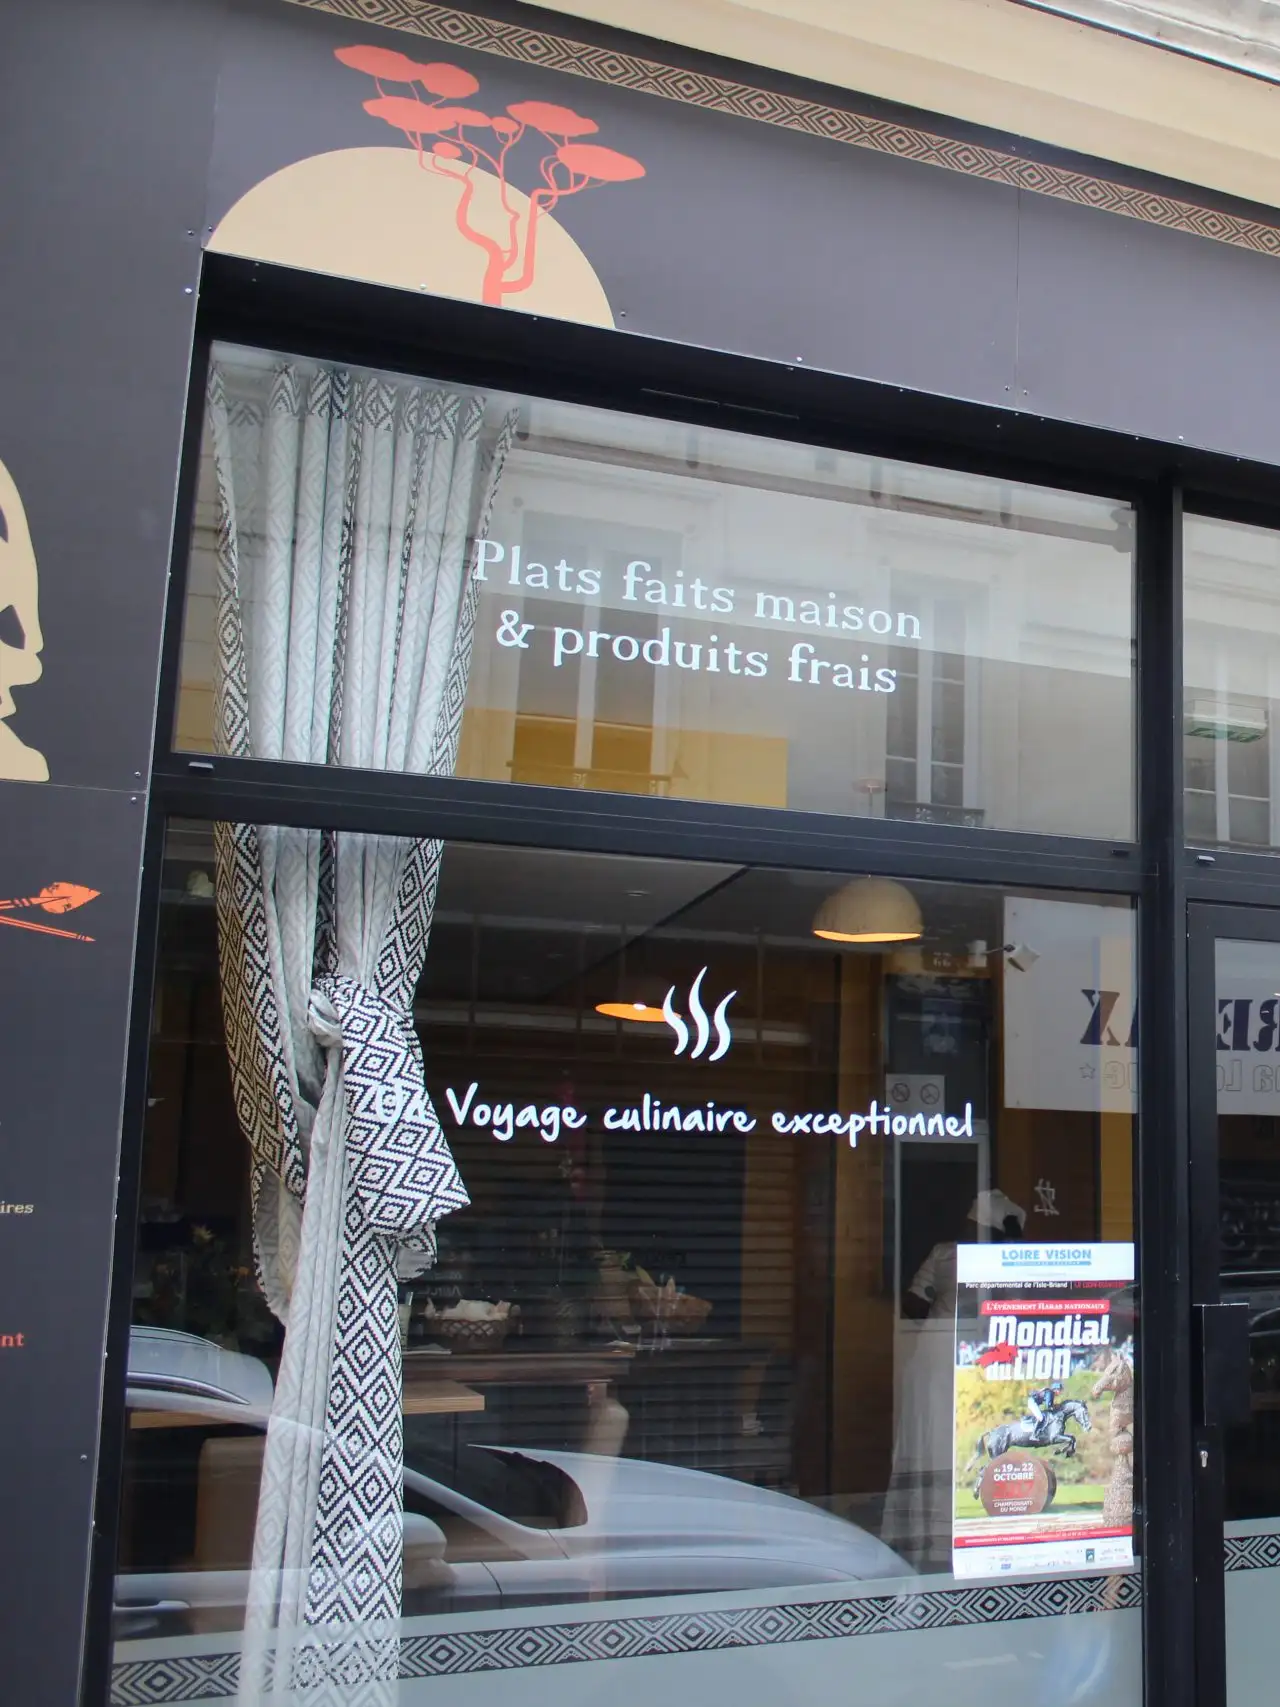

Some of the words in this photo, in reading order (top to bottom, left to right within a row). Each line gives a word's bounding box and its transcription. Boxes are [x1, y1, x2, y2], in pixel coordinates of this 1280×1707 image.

[472, 539, 601, 595] Plats
[622, 560, 735, 613] faits
[754, 591, 922, 640] maison
[495, 609, 529, 648] &
[553, 627, 768, 677] produits
[787, 643, 897, 693] frais
[446, 1082, 588, 1142] Voyage
[603, 1093, 757, 1133] culinaire
[771, 1101, 973, 1148] exceptionnel
[988, 1314, 1110, 1347] Mondial
